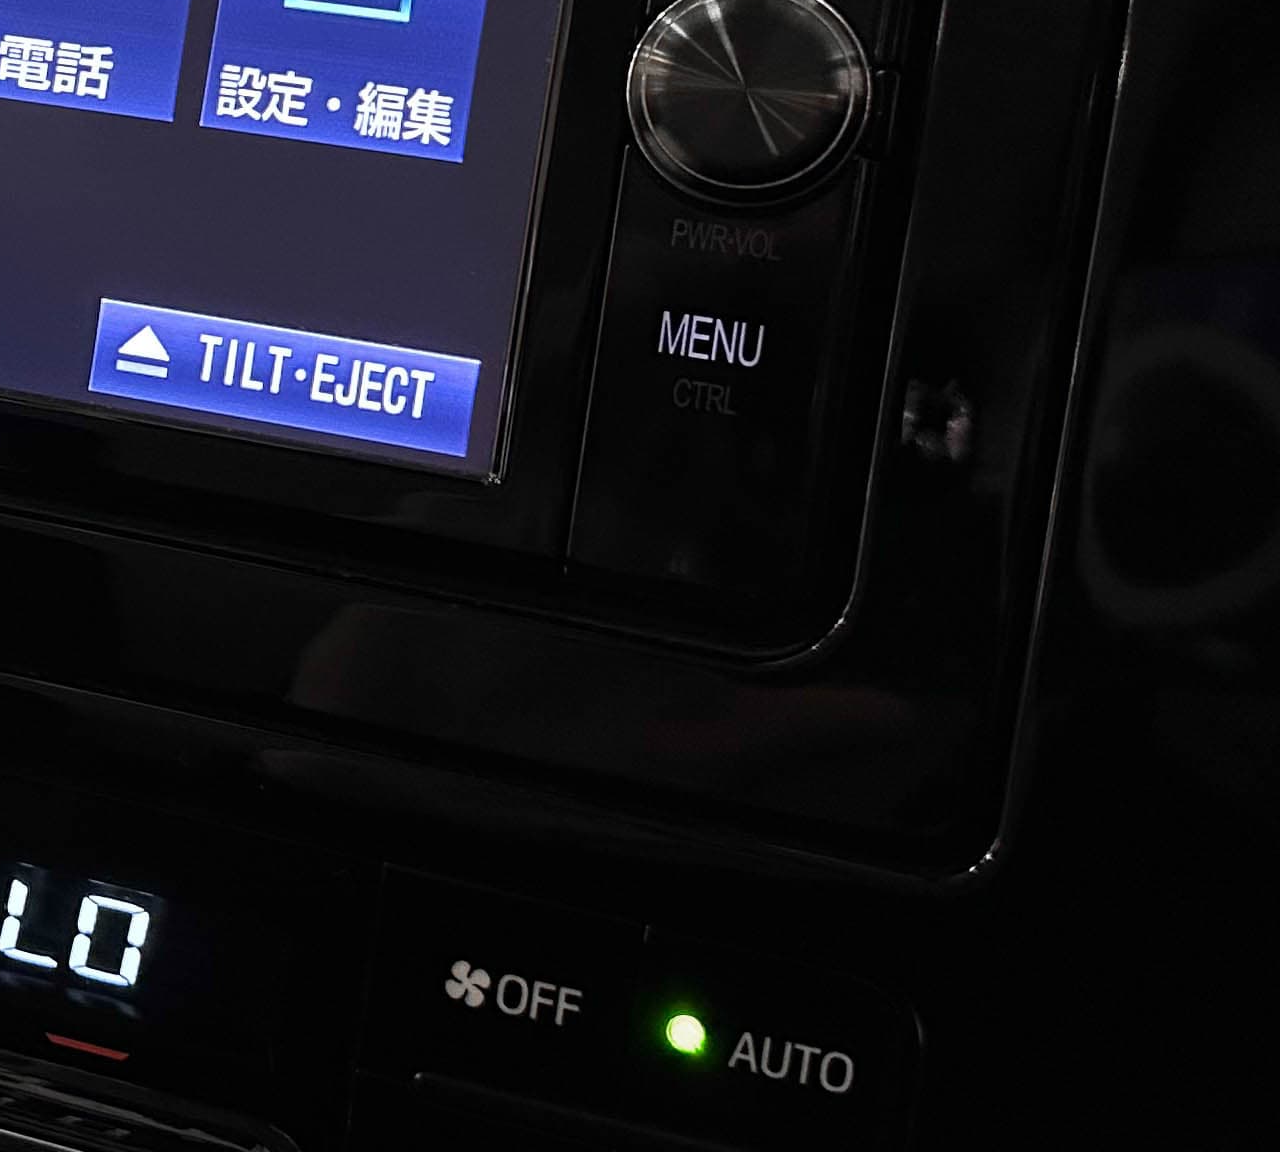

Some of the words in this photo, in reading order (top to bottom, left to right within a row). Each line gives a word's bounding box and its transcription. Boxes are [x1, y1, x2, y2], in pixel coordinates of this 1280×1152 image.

[216, 64, 455, 146] 設定・編集
[657, 310, 766, 367] MENU
[672, 377, 737, 416] CTRL
[496, 974, 584, 1026] OFF
[728, 1031, 855, 1094] AUTO
